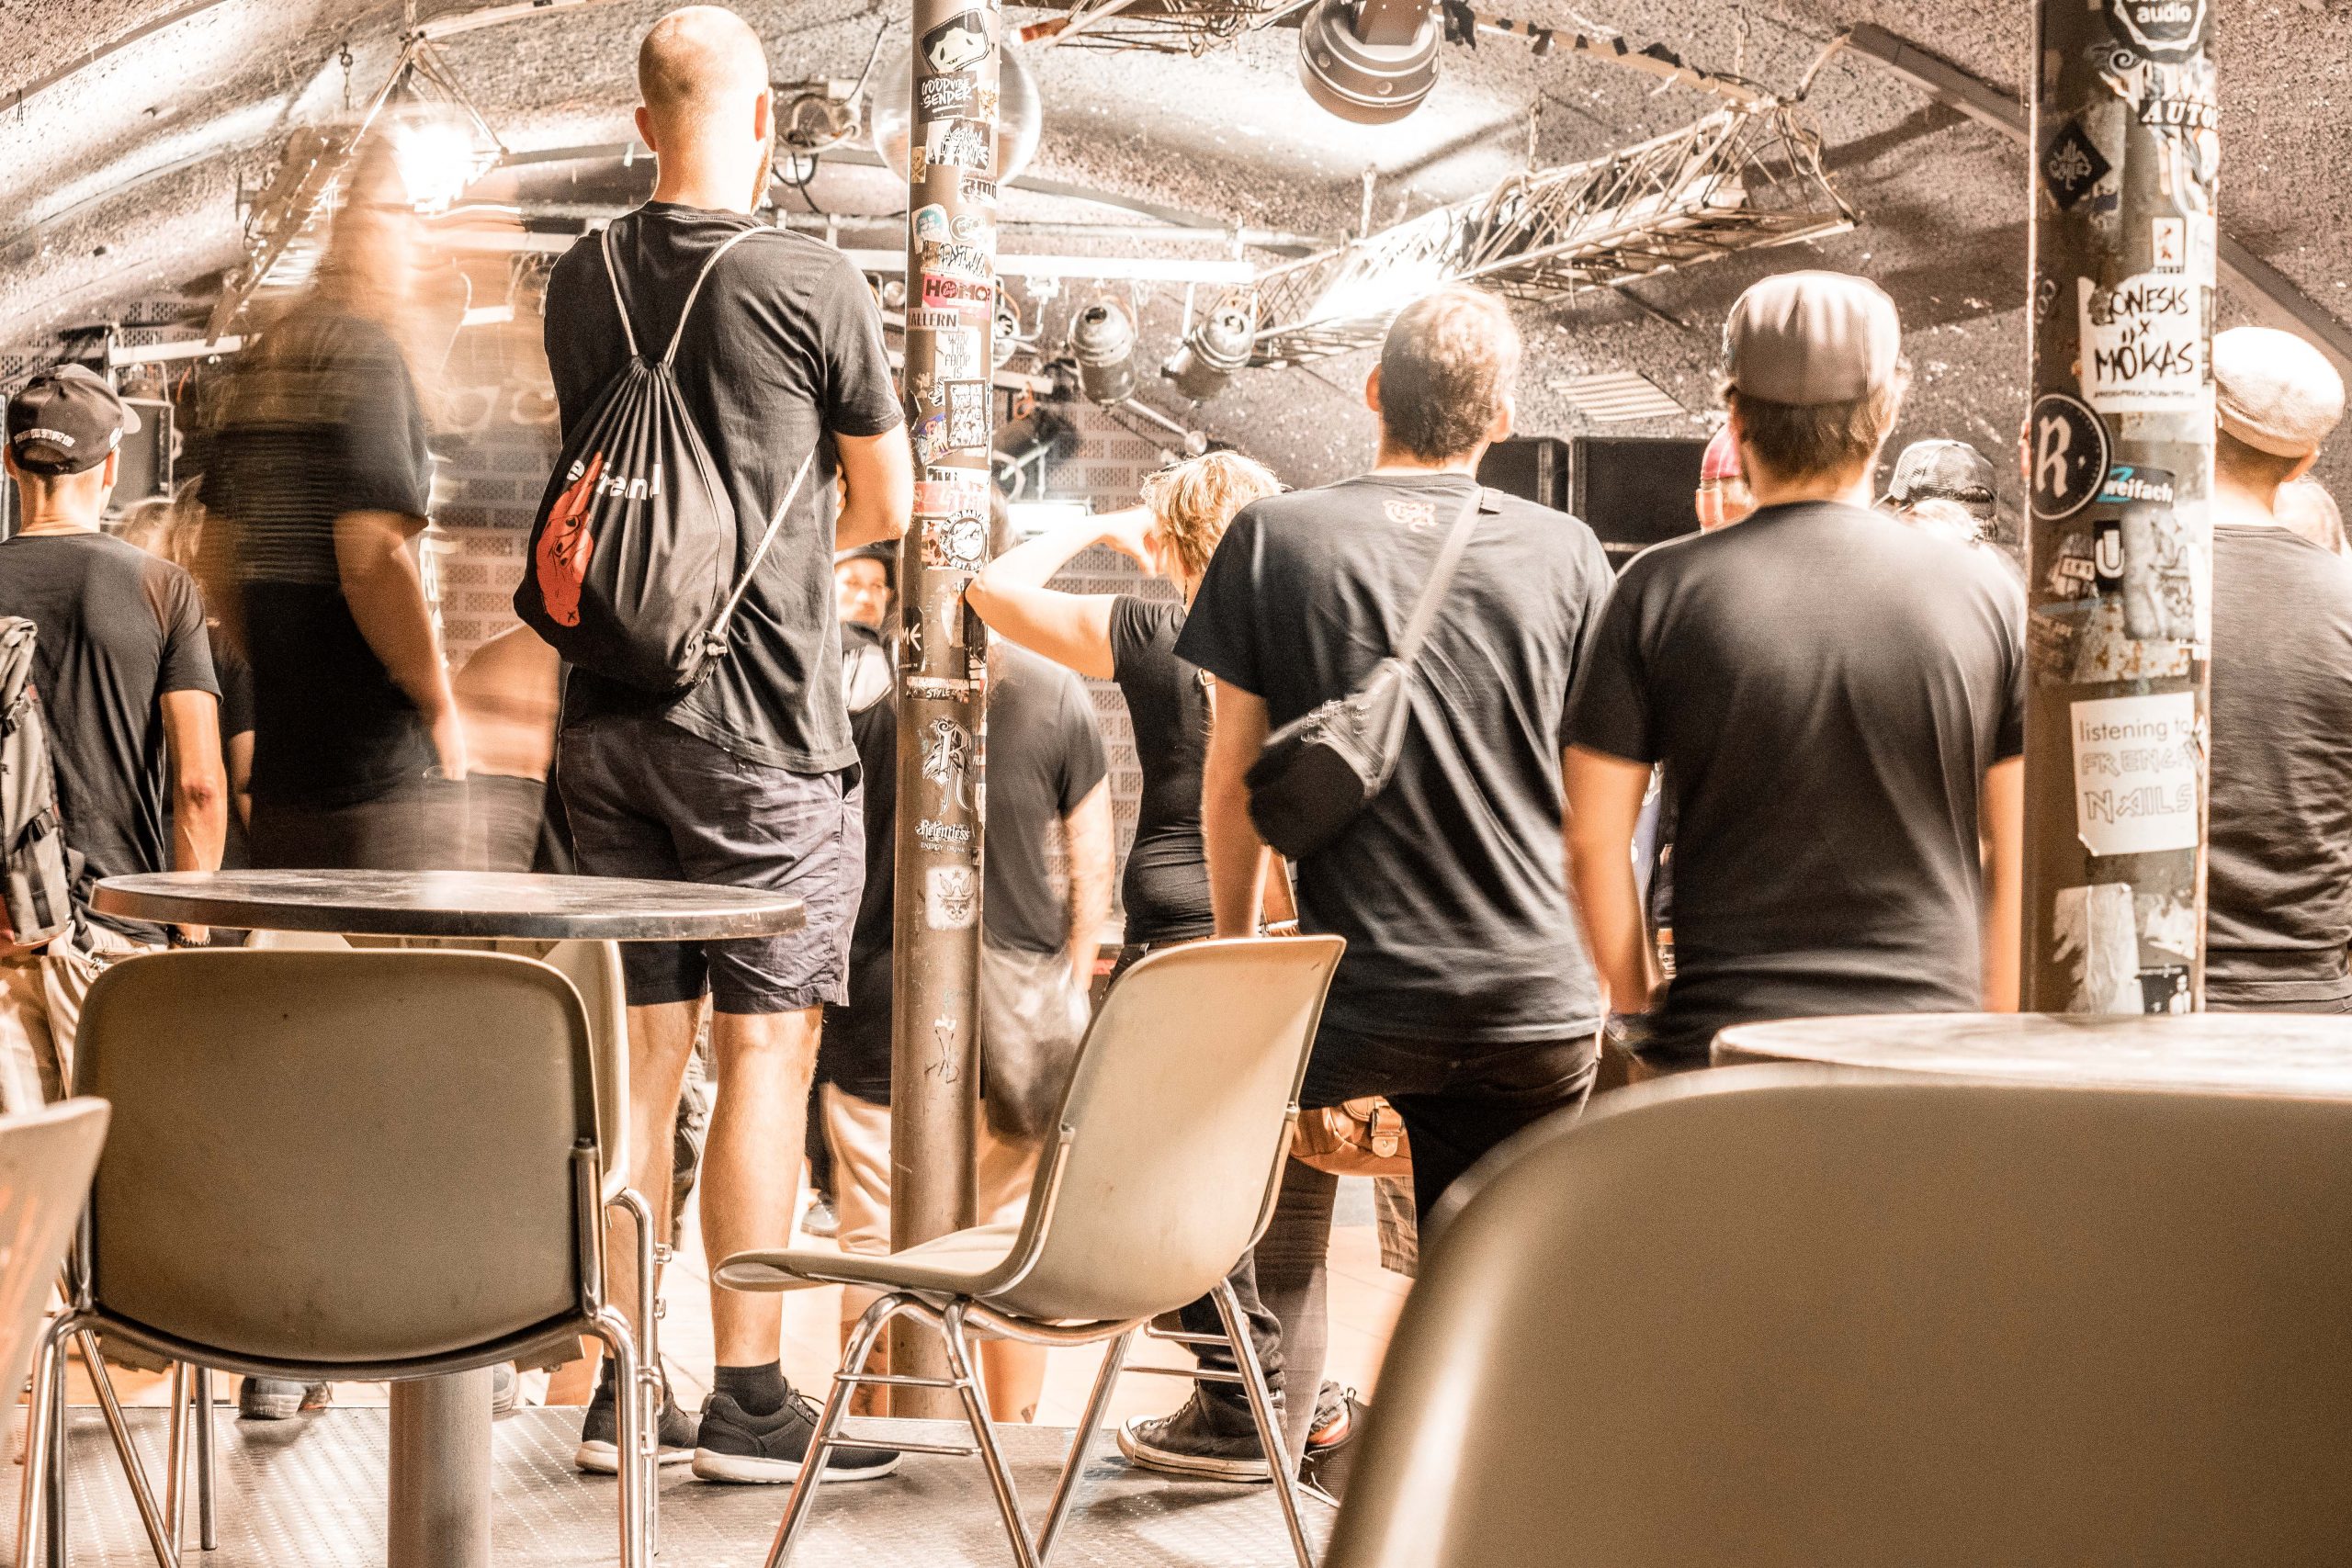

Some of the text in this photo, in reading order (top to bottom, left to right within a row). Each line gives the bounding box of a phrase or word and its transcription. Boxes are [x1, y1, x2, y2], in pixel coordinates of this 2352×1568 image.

[2136, 2, 2192, 23] audio
[2079, 719, 2168, 743] listening
[2083, 784, 2192, 824] NAILS
